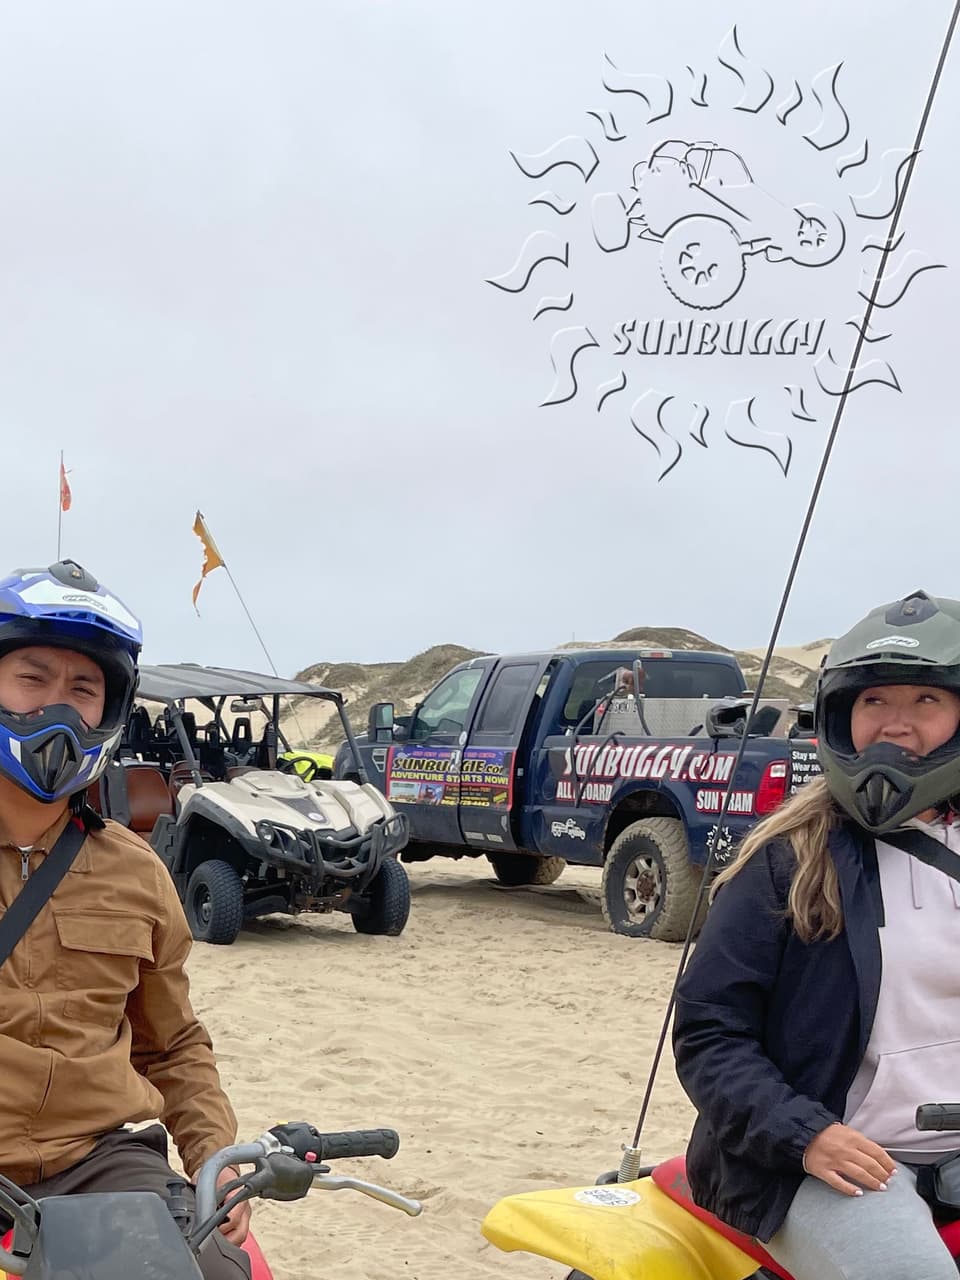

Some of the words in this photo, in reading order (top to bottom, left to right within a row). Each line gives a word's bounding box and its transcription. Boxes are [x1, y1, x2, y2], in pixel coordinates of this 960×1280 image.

[792, 751, 807, 761] Stay
[392, 757, 504, 775] SUNBUGIE.co
[792, 762, 810, 772] Wear
[391, 771, 444, 782] ADVENTURE
[446, 774, 482, 784] STARTS
[484, 775, 509, 785] NOW!
[792, 774, 802, 783] No
[556, 781, 572, 799] ALL
[573, 783, 613, 801] OARD
[696, 790, 719, 810] SUN
